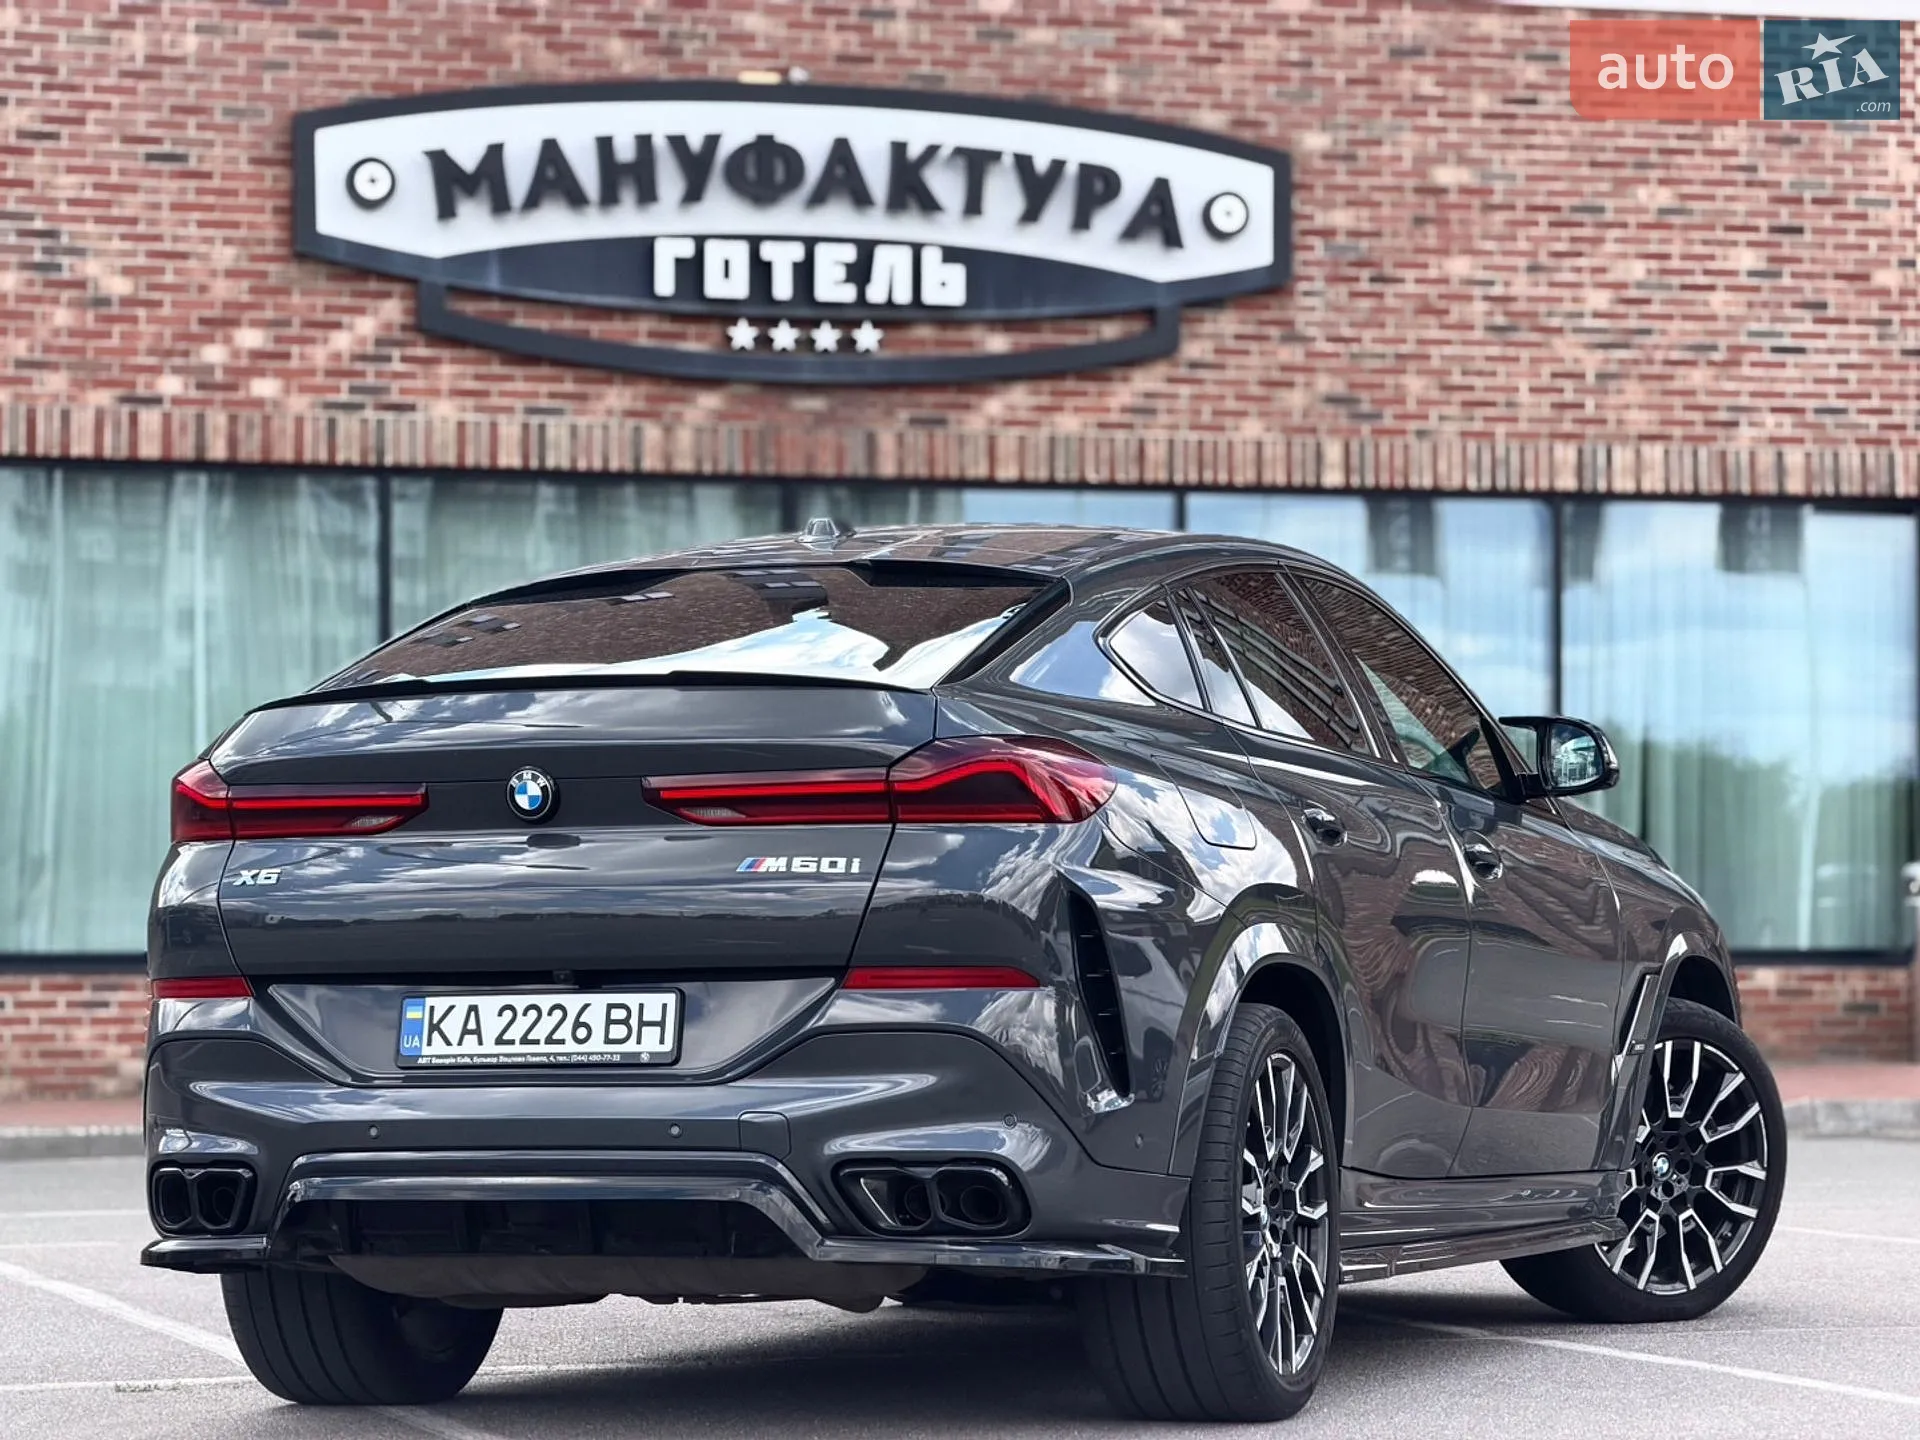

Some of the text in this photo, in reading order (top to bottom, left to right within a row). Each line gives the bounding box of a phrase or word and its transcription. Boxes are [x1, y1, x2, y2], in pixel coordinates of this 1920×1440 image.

[424, 133, 1184, 249] МАНУФАКТУРА
[653, 236, 967, 307] ГОТЕЛЬ
[233, 868, 282, 886] X6
[404, 1034, 420, 1049] UA
[426, 1002, 668, 1047] KA 2226 BH
